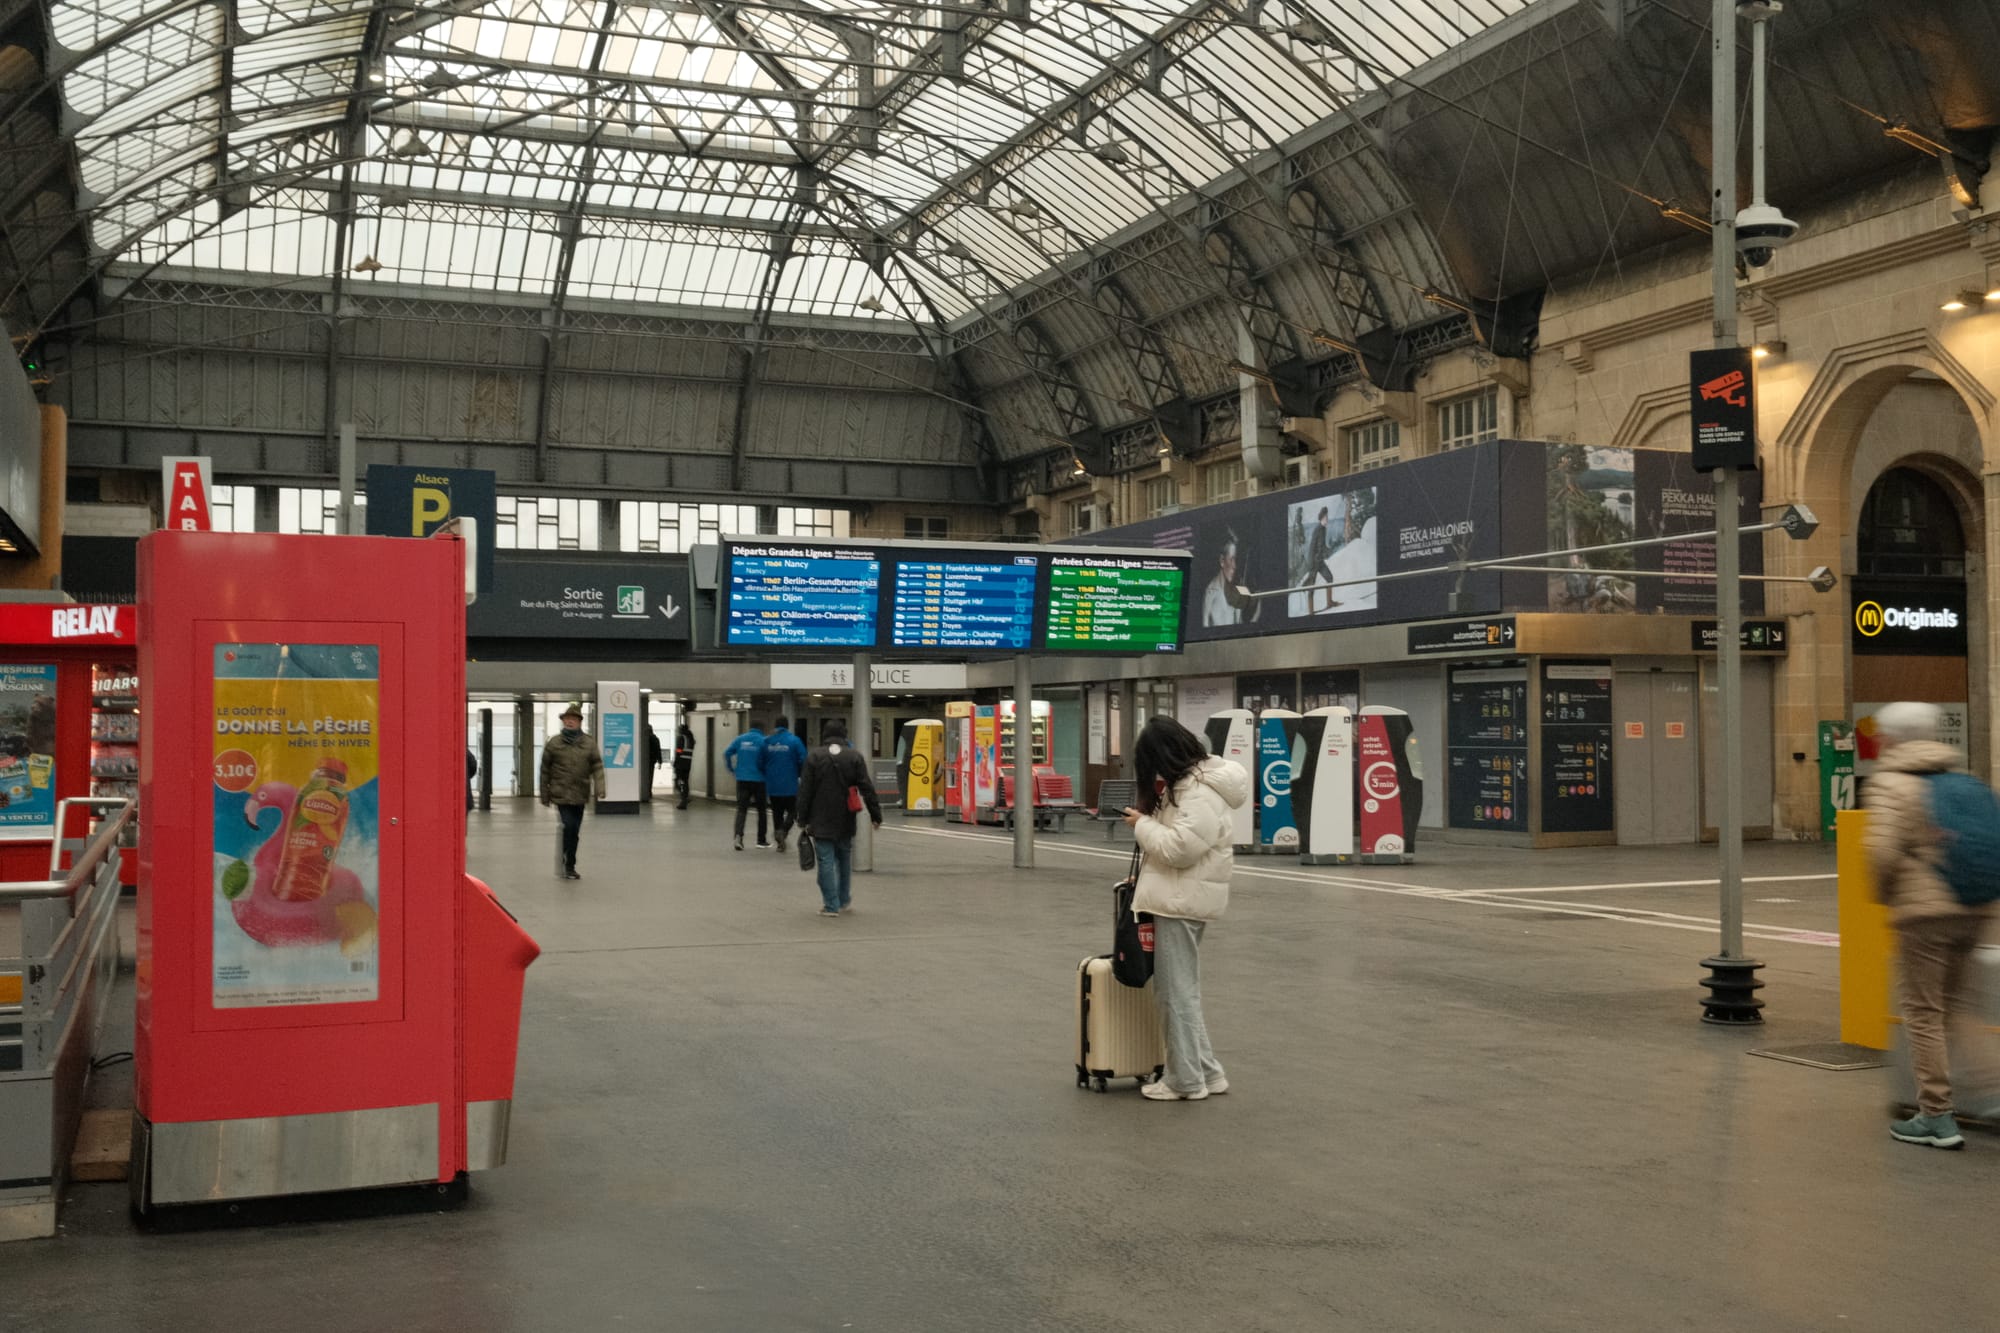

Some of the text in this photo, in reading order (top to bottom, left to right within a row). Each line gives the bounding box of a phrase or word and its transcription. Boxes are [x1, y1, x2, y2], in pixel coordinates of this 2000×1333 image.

[414, 473, 449, 485] Alsace
[1662, 492, 1695, 504] PEKKA
[1696, 493, 1744, 507] HALN
[412, 487, 450, 536] P
[1400, 520, 1474, 545] PEKKA HALONEN
[732, 546, 767, 556] Départs
[768, 547, 804, 557] Grandes
[805, 548, 833, 559] Lignes
[784, 560, 809, 570] Nancy
[1051, 557, 1083, 567] Arrivées
[1084, 558, 1116, 567] Grandes
[1117, 559, 1141, 569] Lignes
[746, 567, 766, 575] Nancy
[1098, 570, 1120, 578] Troyes
[783, 577, 868, 587] Berlin-Gesundbrunnen
[563, 587, 603, 600] Sortie
[791, 585, 837, 593] Hauptbahnhof
[1096, 586, 1118, 594] Nancy
[782, 594, 803, 603] Dijon
[943, 598, 971, 606] Stuttgart
[1084, 593, 1142, 601] Champagne-Ardenne
[520, 600, 534, 608] Rue
[546, 601, 559, 610] Fbg
[560, 601, 603, 609] Saint-Martin
[802, 603, 856, 611] Nogent-sur-Seine
[943, 606, 962, 614] Nancy
[781, 611, 866, 620] Châlons-en-Champagne
[1883, 607, 1959, 630] Originals
[52, 605, 118, 638] RELAY
[942, 622, 962, 630] Troyes
[1093, 618, 1129, 626] Luxembourg
[781, 628, 806, 636] Troyes
[972, 631, 1004, 639] Chalindrey
[1092, 633, 1118, 641] Stuttgart
[764, 636, 819, 644] Nogent-sur-Seine
[217, 707, 229, 716] LE
[232, 705, 264, 716] GOÛT
[217, 716, 370, 734] DONNE LA PÊCHE
[288, 737, 370, 747] MÊME EN HIVER
[215, 764, 254, 778] 3,10€
[1270, 775, 1277, 784] 3
[1371, 777, 1378, 788] 3
[306, 799, 337, 814] Lipton
